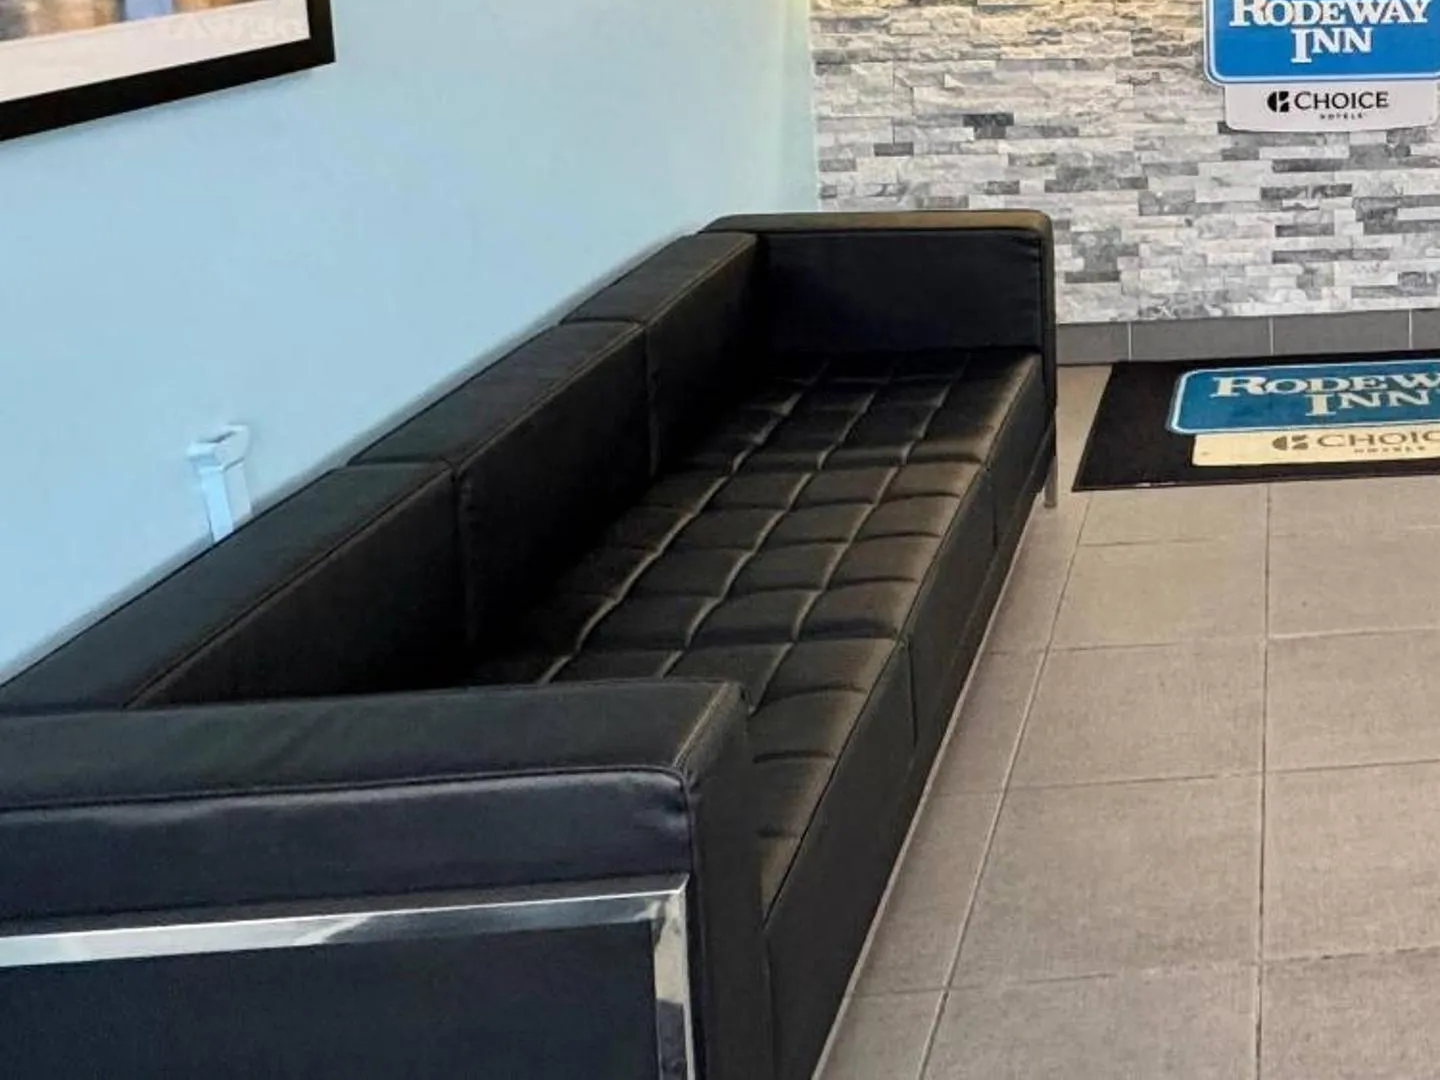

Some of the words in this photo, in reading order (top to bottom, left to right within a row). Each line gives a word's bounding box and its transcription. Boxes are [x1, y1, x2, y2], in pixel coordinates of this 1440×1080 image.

[1290, 27, 1374, 63] INN
[1294, 91, 1389, 111] CHOICE
[1305, 390, 1430, 416] INN
